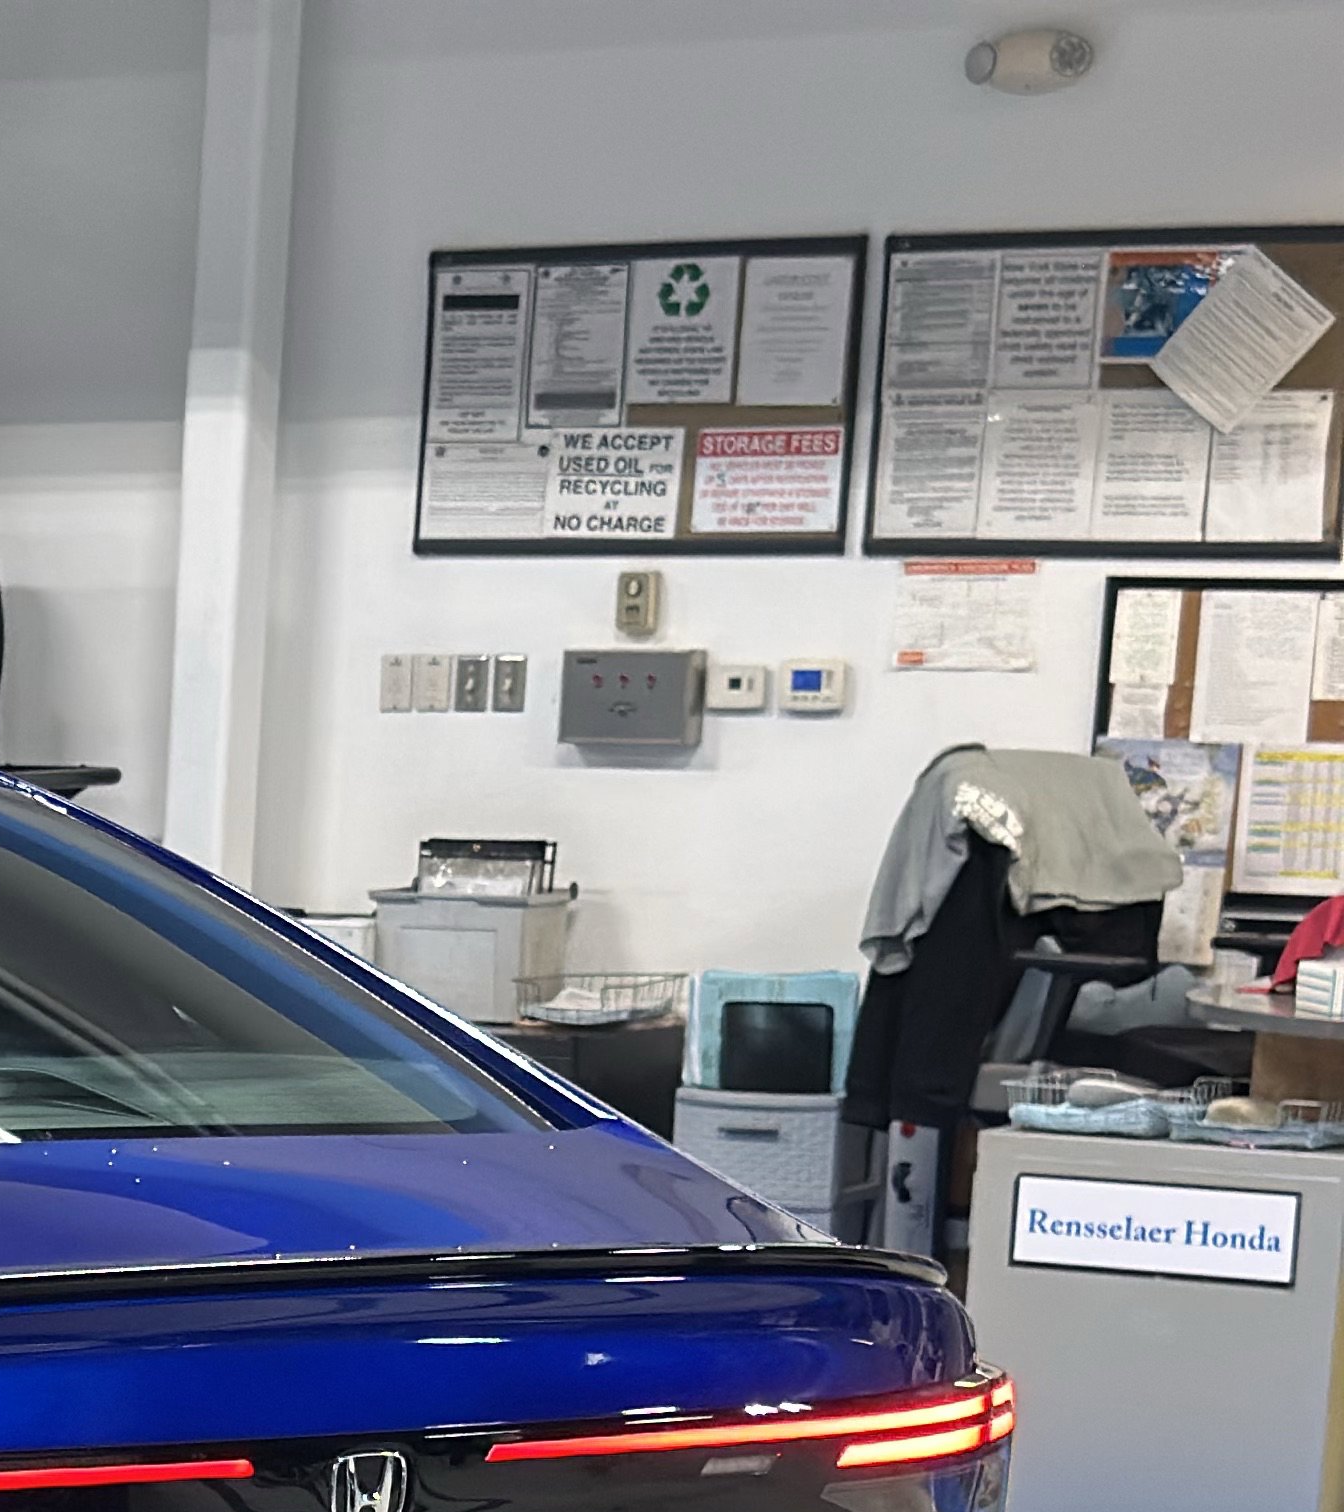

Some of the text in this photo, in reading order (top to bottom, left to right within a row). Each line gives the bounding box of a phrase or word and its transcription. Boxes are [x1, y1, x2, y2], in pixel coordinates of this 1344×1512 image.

[564, 434, 673, 451] WE ACCEPT
[703, 433, 837, 454] STORAGE FEES
[558, 456, 609, 473] USED
[614, 456, 644, 474] OIL
[559, 479, 666, 497] RECYCLING
[604, 501, 619, 510] AT
[554, 514, 666, 532] NO CHARGE
[1027, 1208, 1281, 1253] Rensselaer Honda
